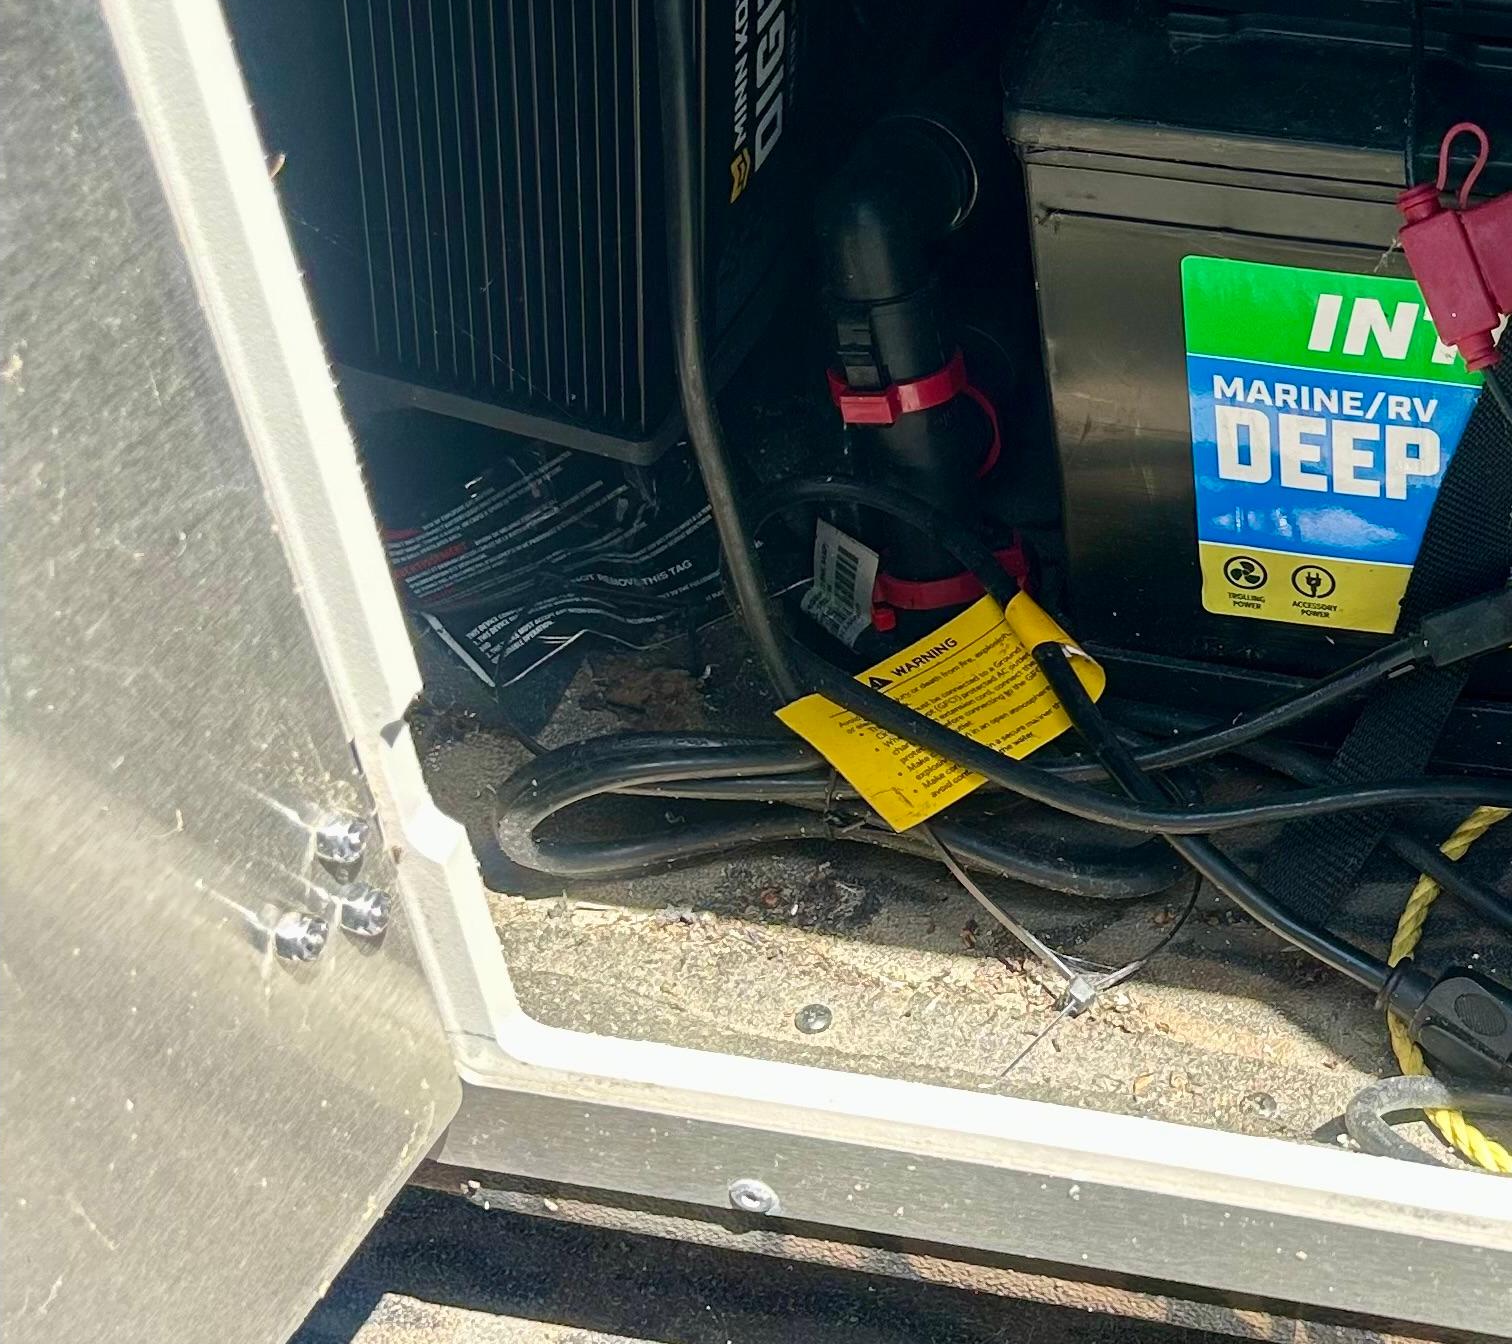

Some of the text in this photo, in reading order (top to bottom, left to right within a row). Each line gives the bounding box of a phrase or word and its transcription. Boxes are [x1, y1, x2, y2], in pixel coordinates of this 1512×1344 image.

[734, 52, 748, 151] MINN
[1213, 374, 1438, 423] MARINE/RV
[1215, 404, 1440, 500] DEEP
[641, 558, 693, 587] THIS TAG
[892, 637, 958, 677] WARNING
[940, 674, 979, 698] connected
[991, 647, 1023, 668] Ground
[941, 663, 960, 676] from
[992, 671, 1023, 690] connect
[965, 679, 1026, 718] connecting the
[989, 711, 1009, 725] open
[1000, 725, 1026, 741] secure
[907, 755, 930, 770] Make
[921, 772, 946, 788] Make
[929, 780, 954, 797] avoid
